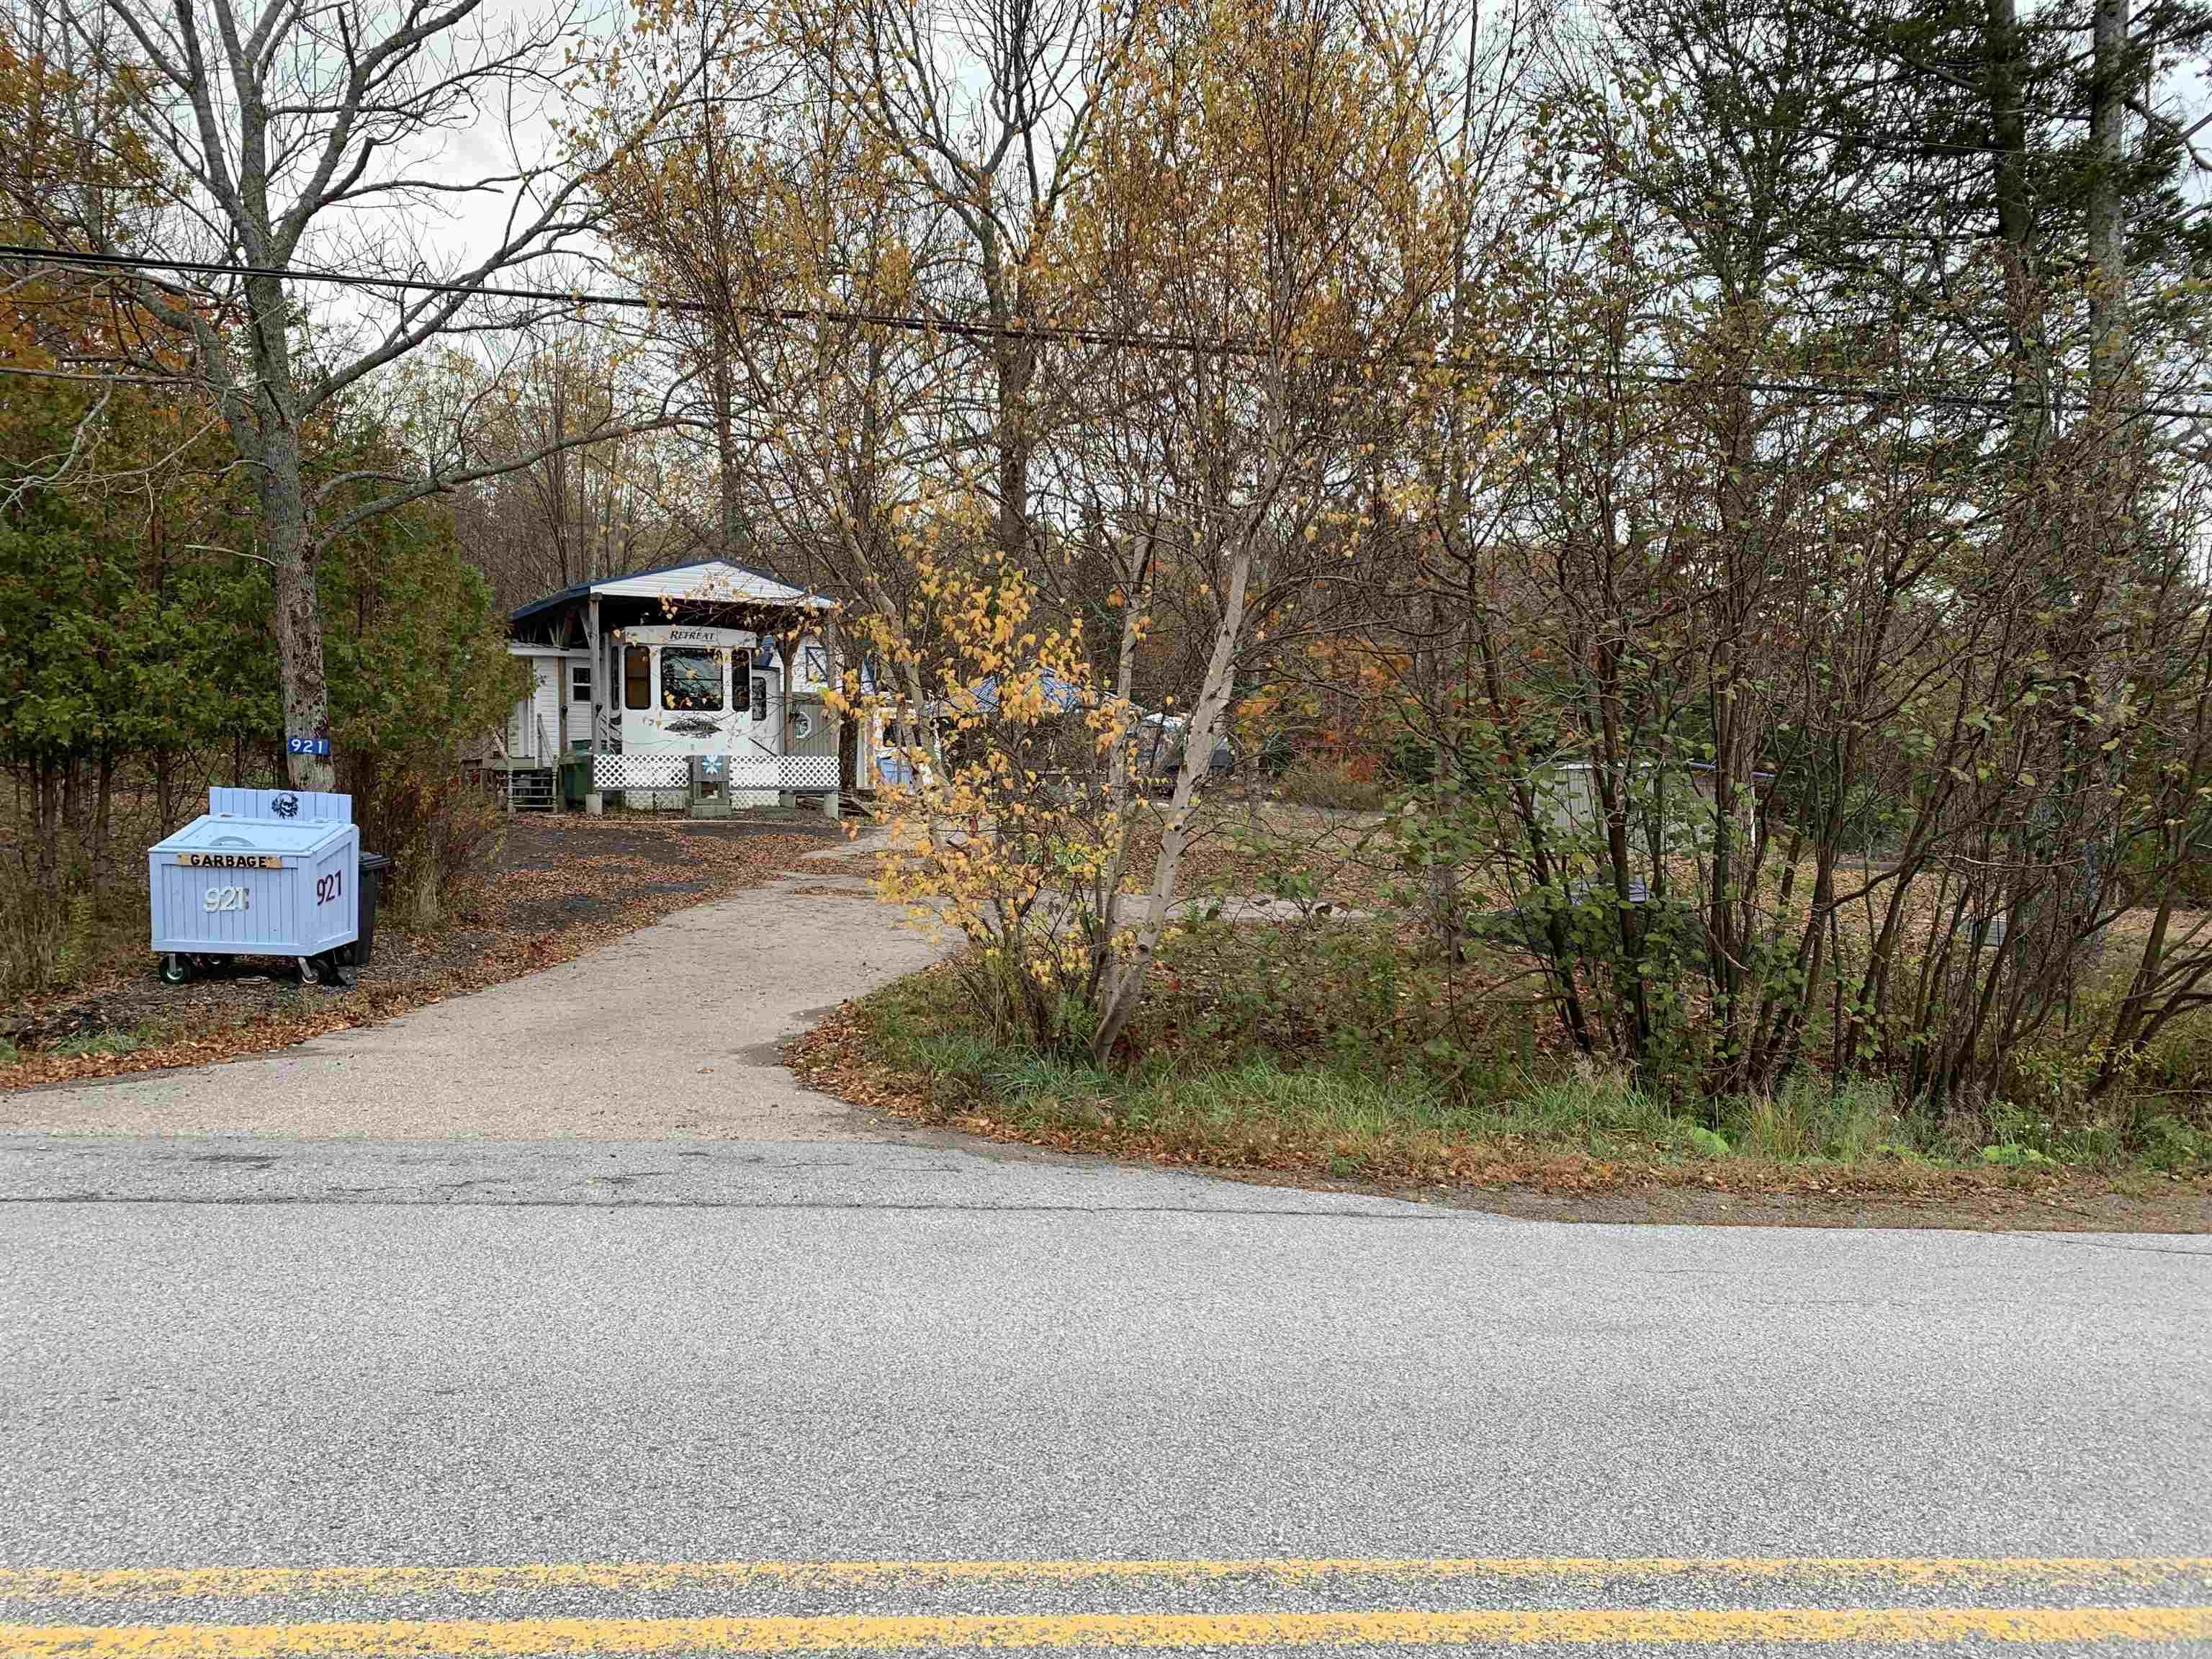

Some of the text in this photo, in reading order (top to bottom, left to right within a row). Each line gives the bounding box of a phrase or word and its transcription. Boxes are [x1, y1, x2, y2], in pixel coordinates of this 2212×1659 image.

[670, 630, 715, 641] RETREAT
[290, 738, 324, 754] 921
[190, 854, 267, 868] GARBAGE
[315, 870, 342, 906] 921
[203, 887, 247, 912] 921
